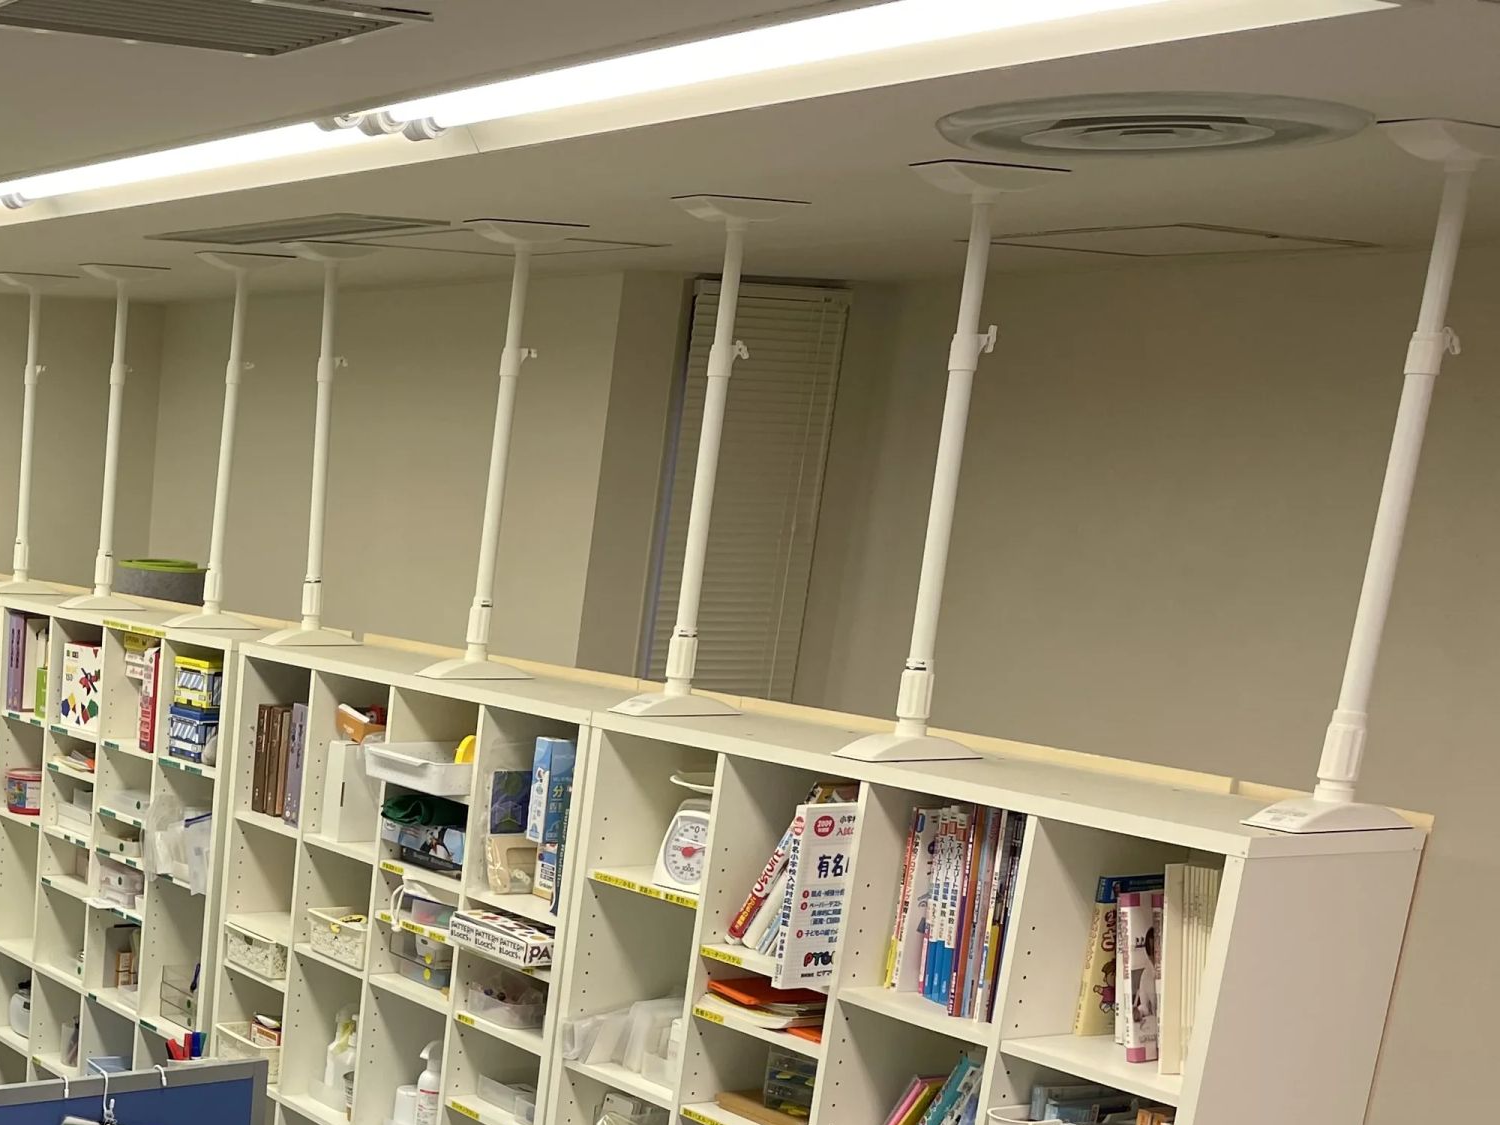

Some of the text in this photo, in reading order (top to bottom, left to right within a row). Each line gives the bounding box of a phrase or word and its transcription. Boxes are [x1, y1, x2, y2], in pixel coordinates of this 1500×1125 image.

[817, 854, 850, 879] 有名
[451, 920, 475, 934] PATTERN
[475, 929, 499, 943] PATTERN
[500, 938, 524, 952] PATTERN
[529, 945, 554, 963] PA
